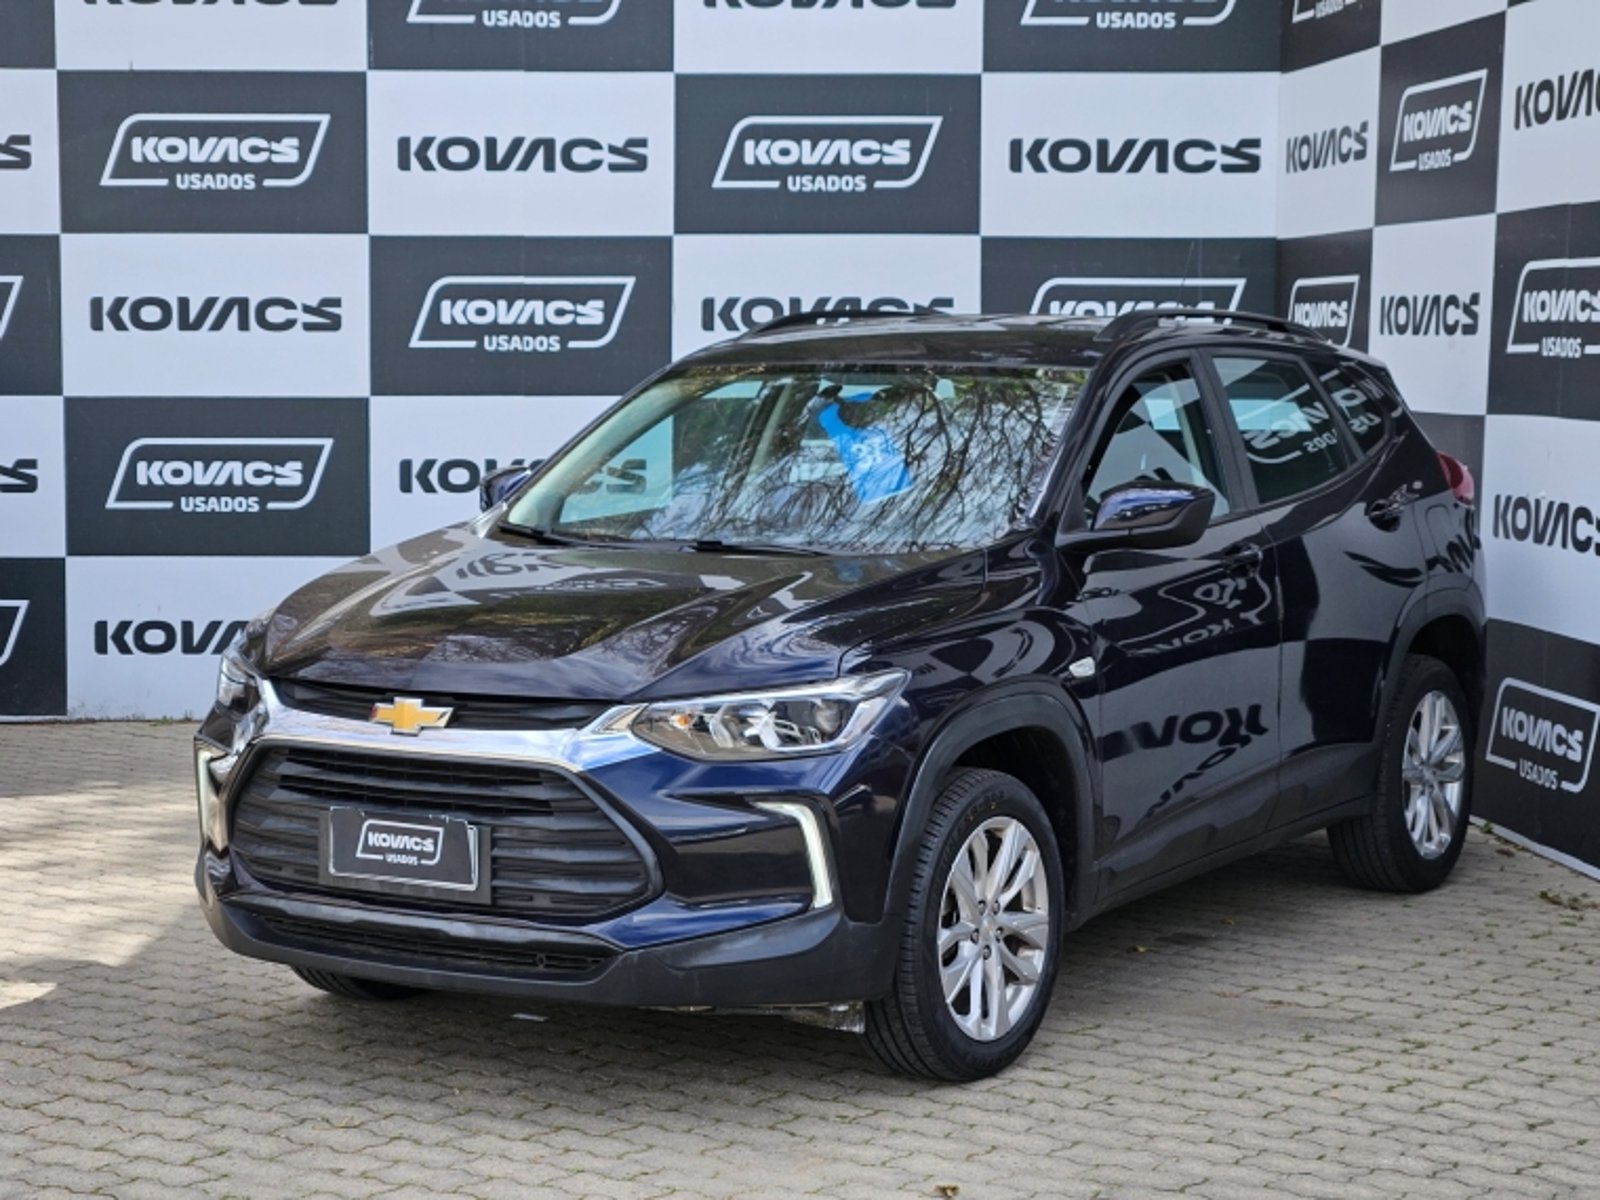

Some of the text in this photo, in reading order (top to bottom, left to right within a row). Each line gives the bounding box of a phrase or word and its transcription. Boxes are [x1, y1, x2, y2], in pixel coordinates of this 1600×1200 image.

[482, 9, 561, 28] USADOS
[1096, 11, 1176, 29] USADOS
[1514, 68, 1600, 131] KOVA
[1402, 100, 1472, 142] KOVACS
[131, 136, 301, 165] KOVACS
[397, 136, 648, 173] KOVACS
[744, 138, 911, 166] KOVACS
[1009, 138, 1262, 174] KOVACS
[1286, 120, 1369, 174] KOVACS
[1418, 148, 1452, 171] USADOS
[175, 173, 256, 190] USADOS
[787, 174, 867, 192] USADOS
[89, 296, 342, 332] KOVACS
[439, 299, 605, 325] KOVACS
[1294, 300, 1348, 327] KOVACS
[1380, 292, 1481, 336] KOVACS
[483, 334, 561, 352] USADOS
[1541, 336, 1582, 359] USADOS
[136, 460, 303, 486] KOVACS
[180, 496, 260, 513] USADOS
[1492, 494, 1600, 557] KOVAC
[1502, 706, 1584, 763] KOVACS
[1519, 758, 1558, 790] USADOS
[367, 831, 435, 853] KOVACS
